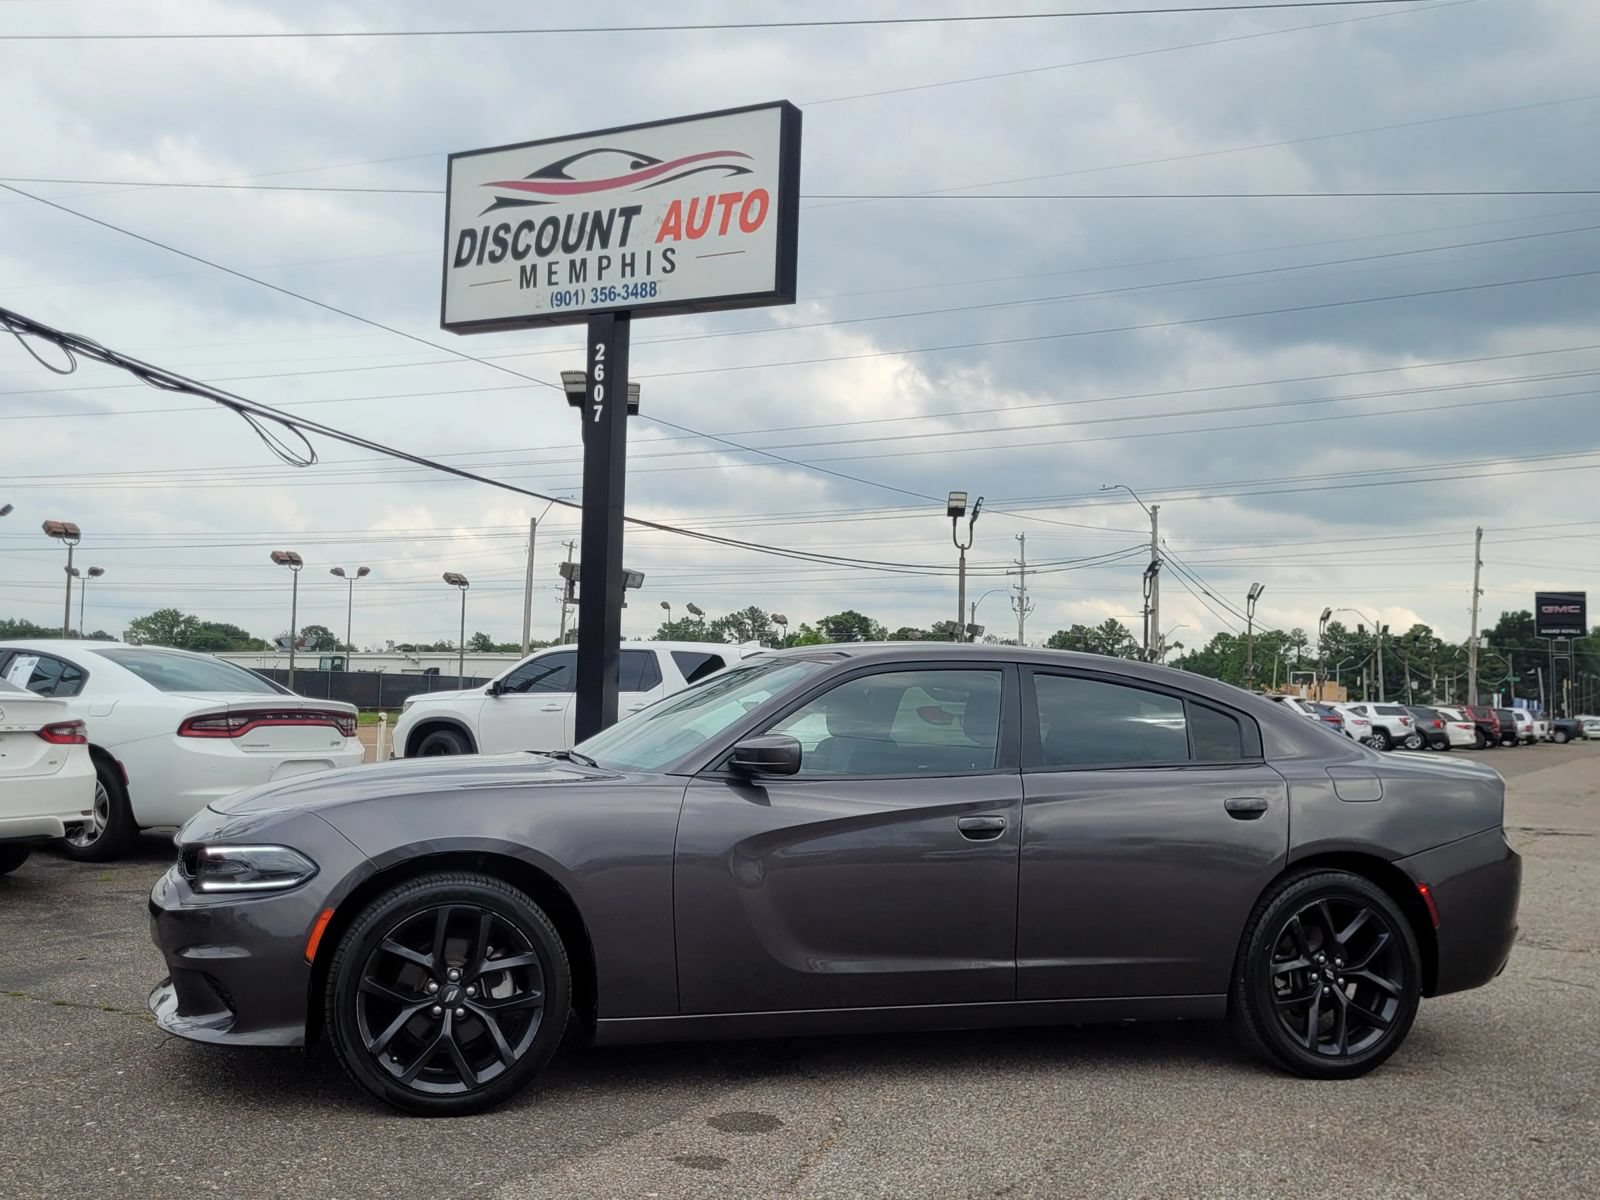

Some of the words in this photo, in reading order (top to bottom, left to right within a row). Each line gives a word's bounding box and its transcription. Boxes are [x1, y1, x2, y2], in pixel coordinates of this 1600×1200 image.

[453, 204, 643, 268] DISCOUNT
[655, 188, 769, 243] AUTO
[519, 247, 676, 289] MEMPHIS
[550, 288, 586, 308] (901)
[590, 280, 657, 304] 356-3488
[593, 343, 605, 422] 2607
[1541, 605, 1580, 613] GMC
